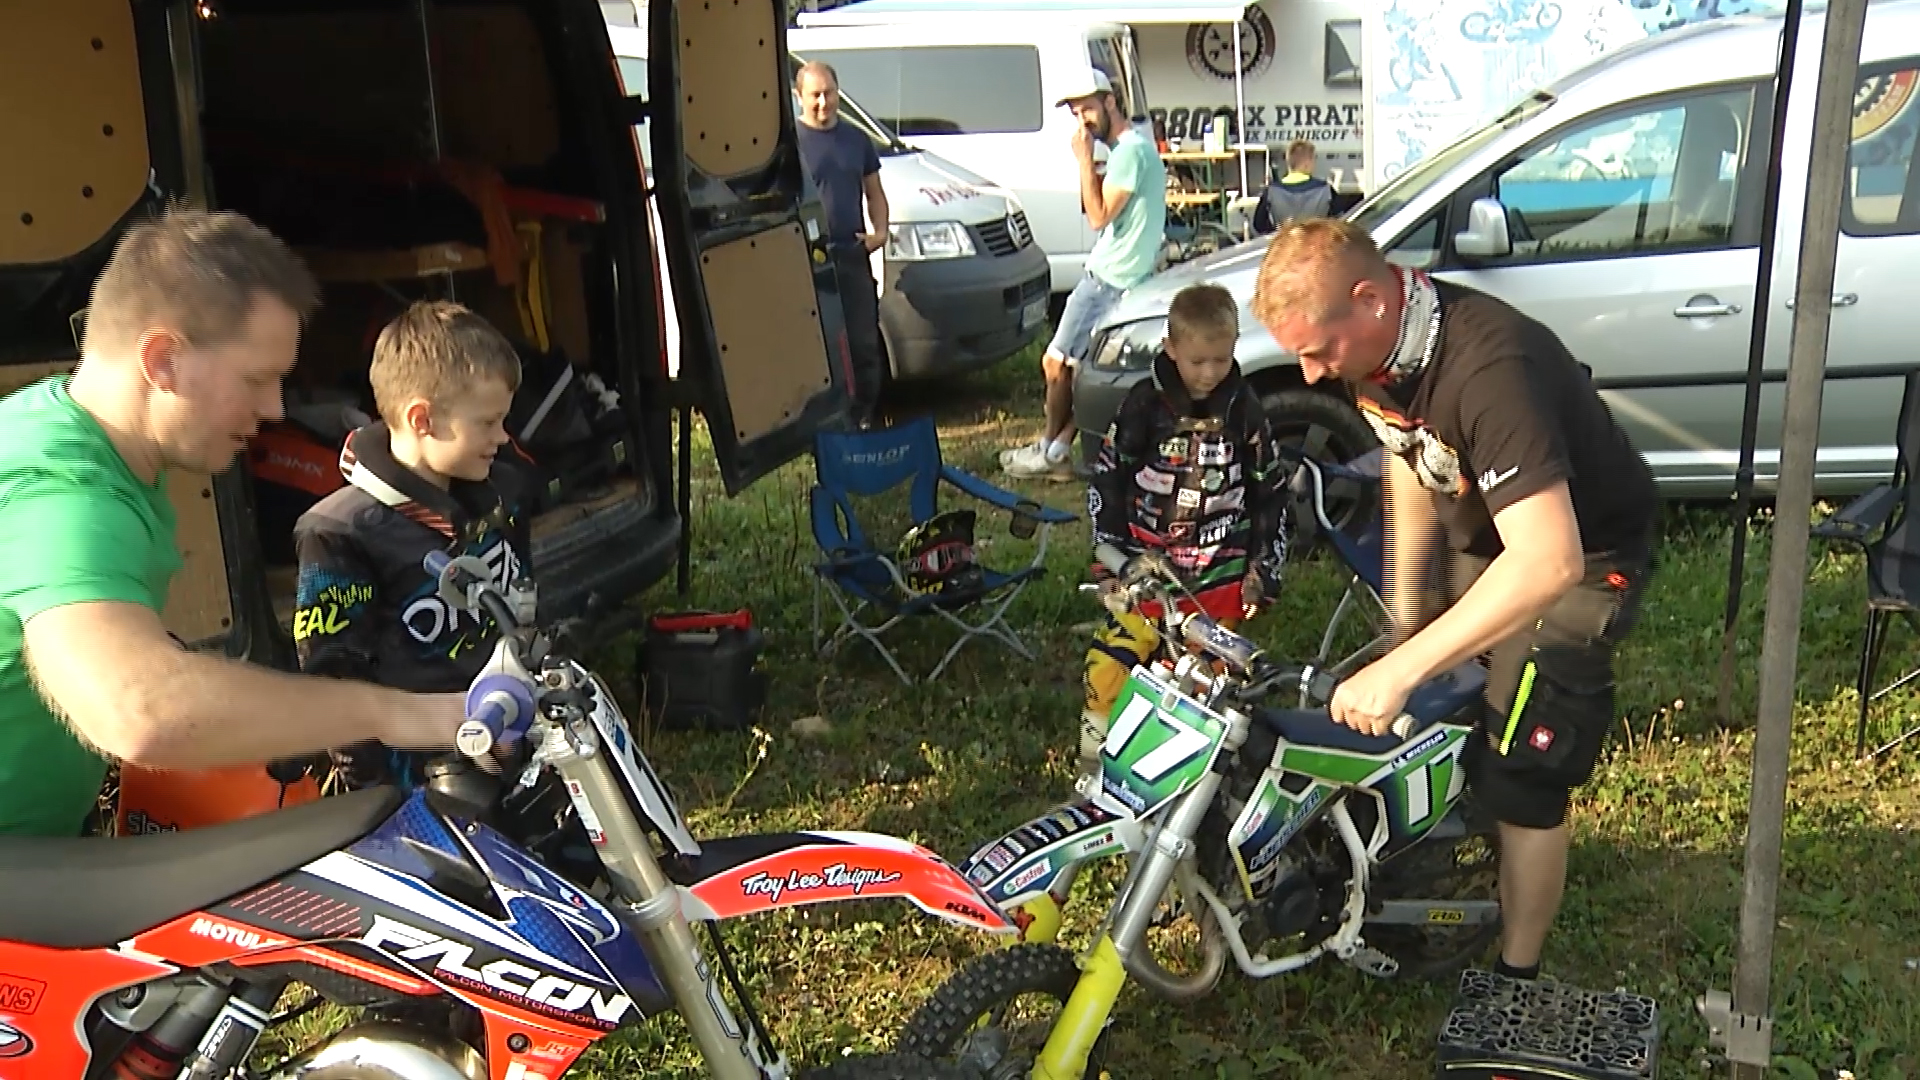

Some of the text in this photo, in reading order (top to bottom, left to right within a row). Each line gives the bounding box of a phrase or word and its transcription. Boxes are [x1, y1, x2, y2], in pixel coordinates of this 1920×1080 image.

[1275, 104, 1363, 126] PIRAT
[1105, 692, 1213, 783] 17
[741, 862, 902, 902] Troy Lee Designs
[1015, 862, 1047, 887] Castrol
[189, 918, 270, 949] MOTUL
[362, 913, 633, 1024] FALCON
[433, 968, 618, 1030] FALCON MOTORSPORTS
